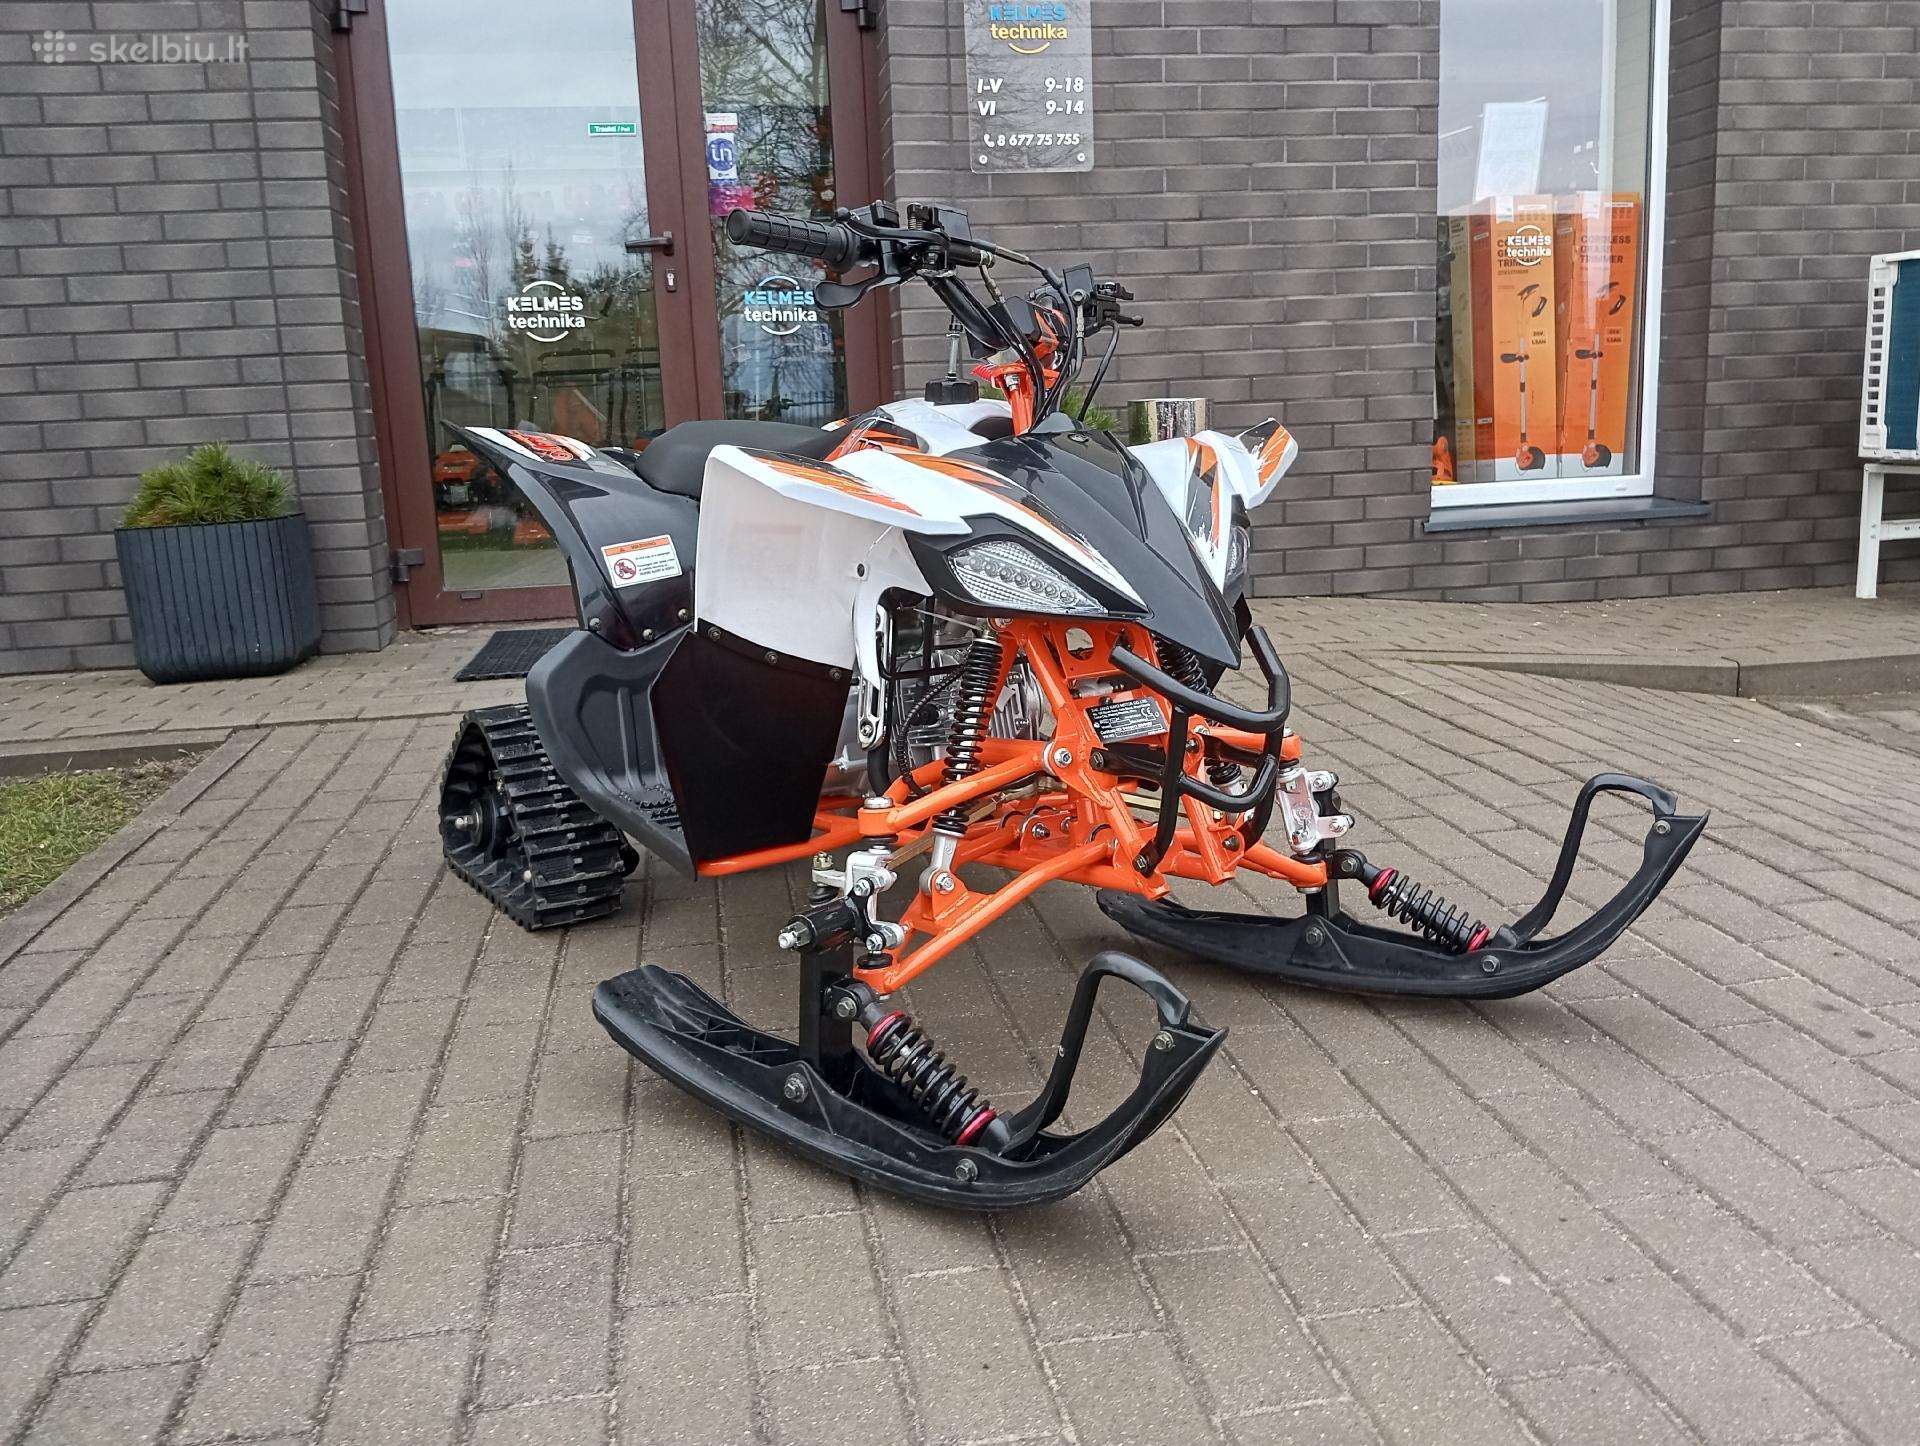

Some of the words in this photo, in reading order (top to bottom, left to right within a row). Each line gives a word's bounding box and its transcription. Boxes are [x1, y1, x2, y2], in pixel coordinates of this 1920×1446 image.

[990, 23, 1068, 40] technika
[977, 78, 1004, 94] I-V
[1044, 77, 1085, 93] 9-18
[978, 100, 997, 116] VI
[1045, 99, 1085, 115] 9-14
[996, 134, 1006, 147] 8
[1008, 134, 1034, 147] 677
[1036, 133, 1053, 146] 75
[1056, 133, 1080, 146] 755
[1507, 246, 1553, 258] technika
[507, 313, 586, 329] technika
[744, 307, 818, 322] technika
